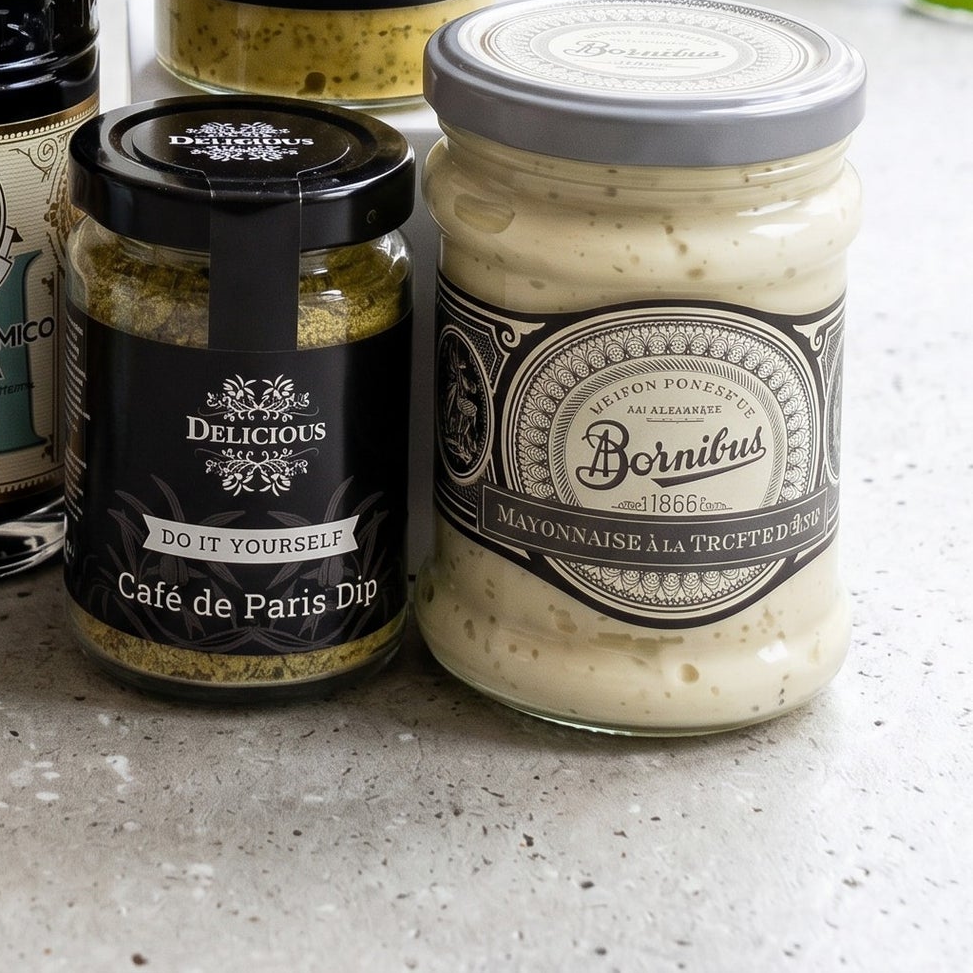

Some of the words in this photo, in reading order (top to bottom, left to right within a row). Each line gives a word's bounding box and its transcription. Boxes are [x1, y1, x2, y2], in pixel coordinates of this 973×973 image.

[186, 415, 327, 445] DELICIOUS
[575, 419, 767, 491] Bornibus
[651, 494, 697, 514] 1866
[161, 528, 192, 548] DO
[199, 535, 221, 552] IT
[230, 528, 344, 555] YOURSELF
[497, 503, 642, 552] MAYONNAISE
[662, 538, 686, 554] LA
[118, 571, 182, 612] Café
[193, 588, 232, 618] de
[244, 588, 327, 619] Paris
[335, 574, 378, 611] Dip
